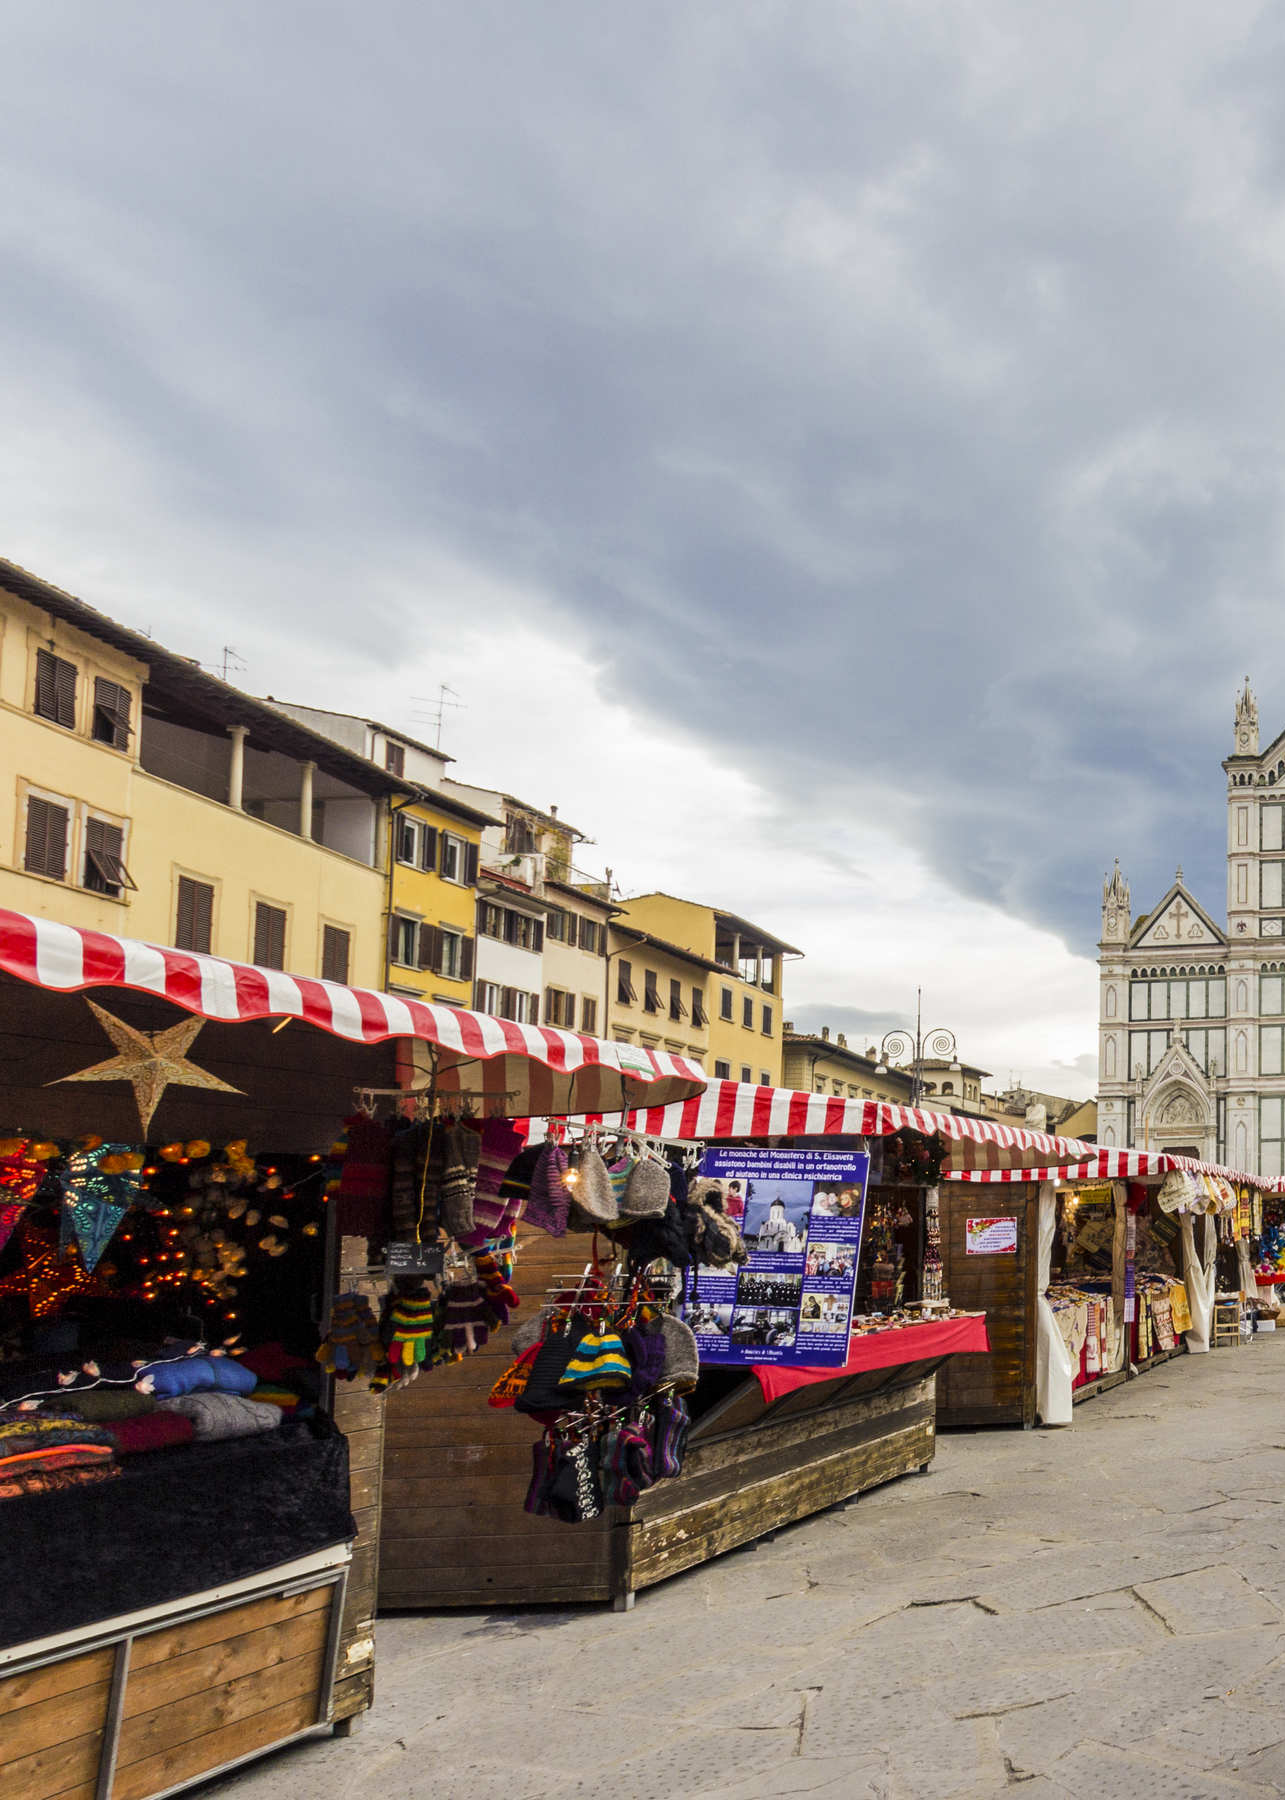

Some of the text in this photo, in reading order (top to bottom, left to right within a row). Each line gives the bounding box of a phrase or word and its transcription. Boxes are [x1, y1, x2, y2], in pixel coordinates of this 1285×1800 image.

[729, 1150, 758, 1158] monache
[770, 1151, 805, 1160] Monastero
[806, 1152, 813, 1160] di
[814, 1152, 822, 1160] S.
[823, 1153, 854, 1161] Elisaveta
[715, 1160, 745, 1168] assistono
[747, 1161, 772, 1169] bambini
[773, 1161, 796, 1169] disabili
[798, 1162, 804, 1170] in
[816, 1163, 857, 1172] orfanotrofio
[726, 1170, 734, 1178] ed
[735, 1171, 759, 1179] aiutano
[781, 1172, 802, 1180] clinica
[804, 1173, 842, 1181] psichiatrica
